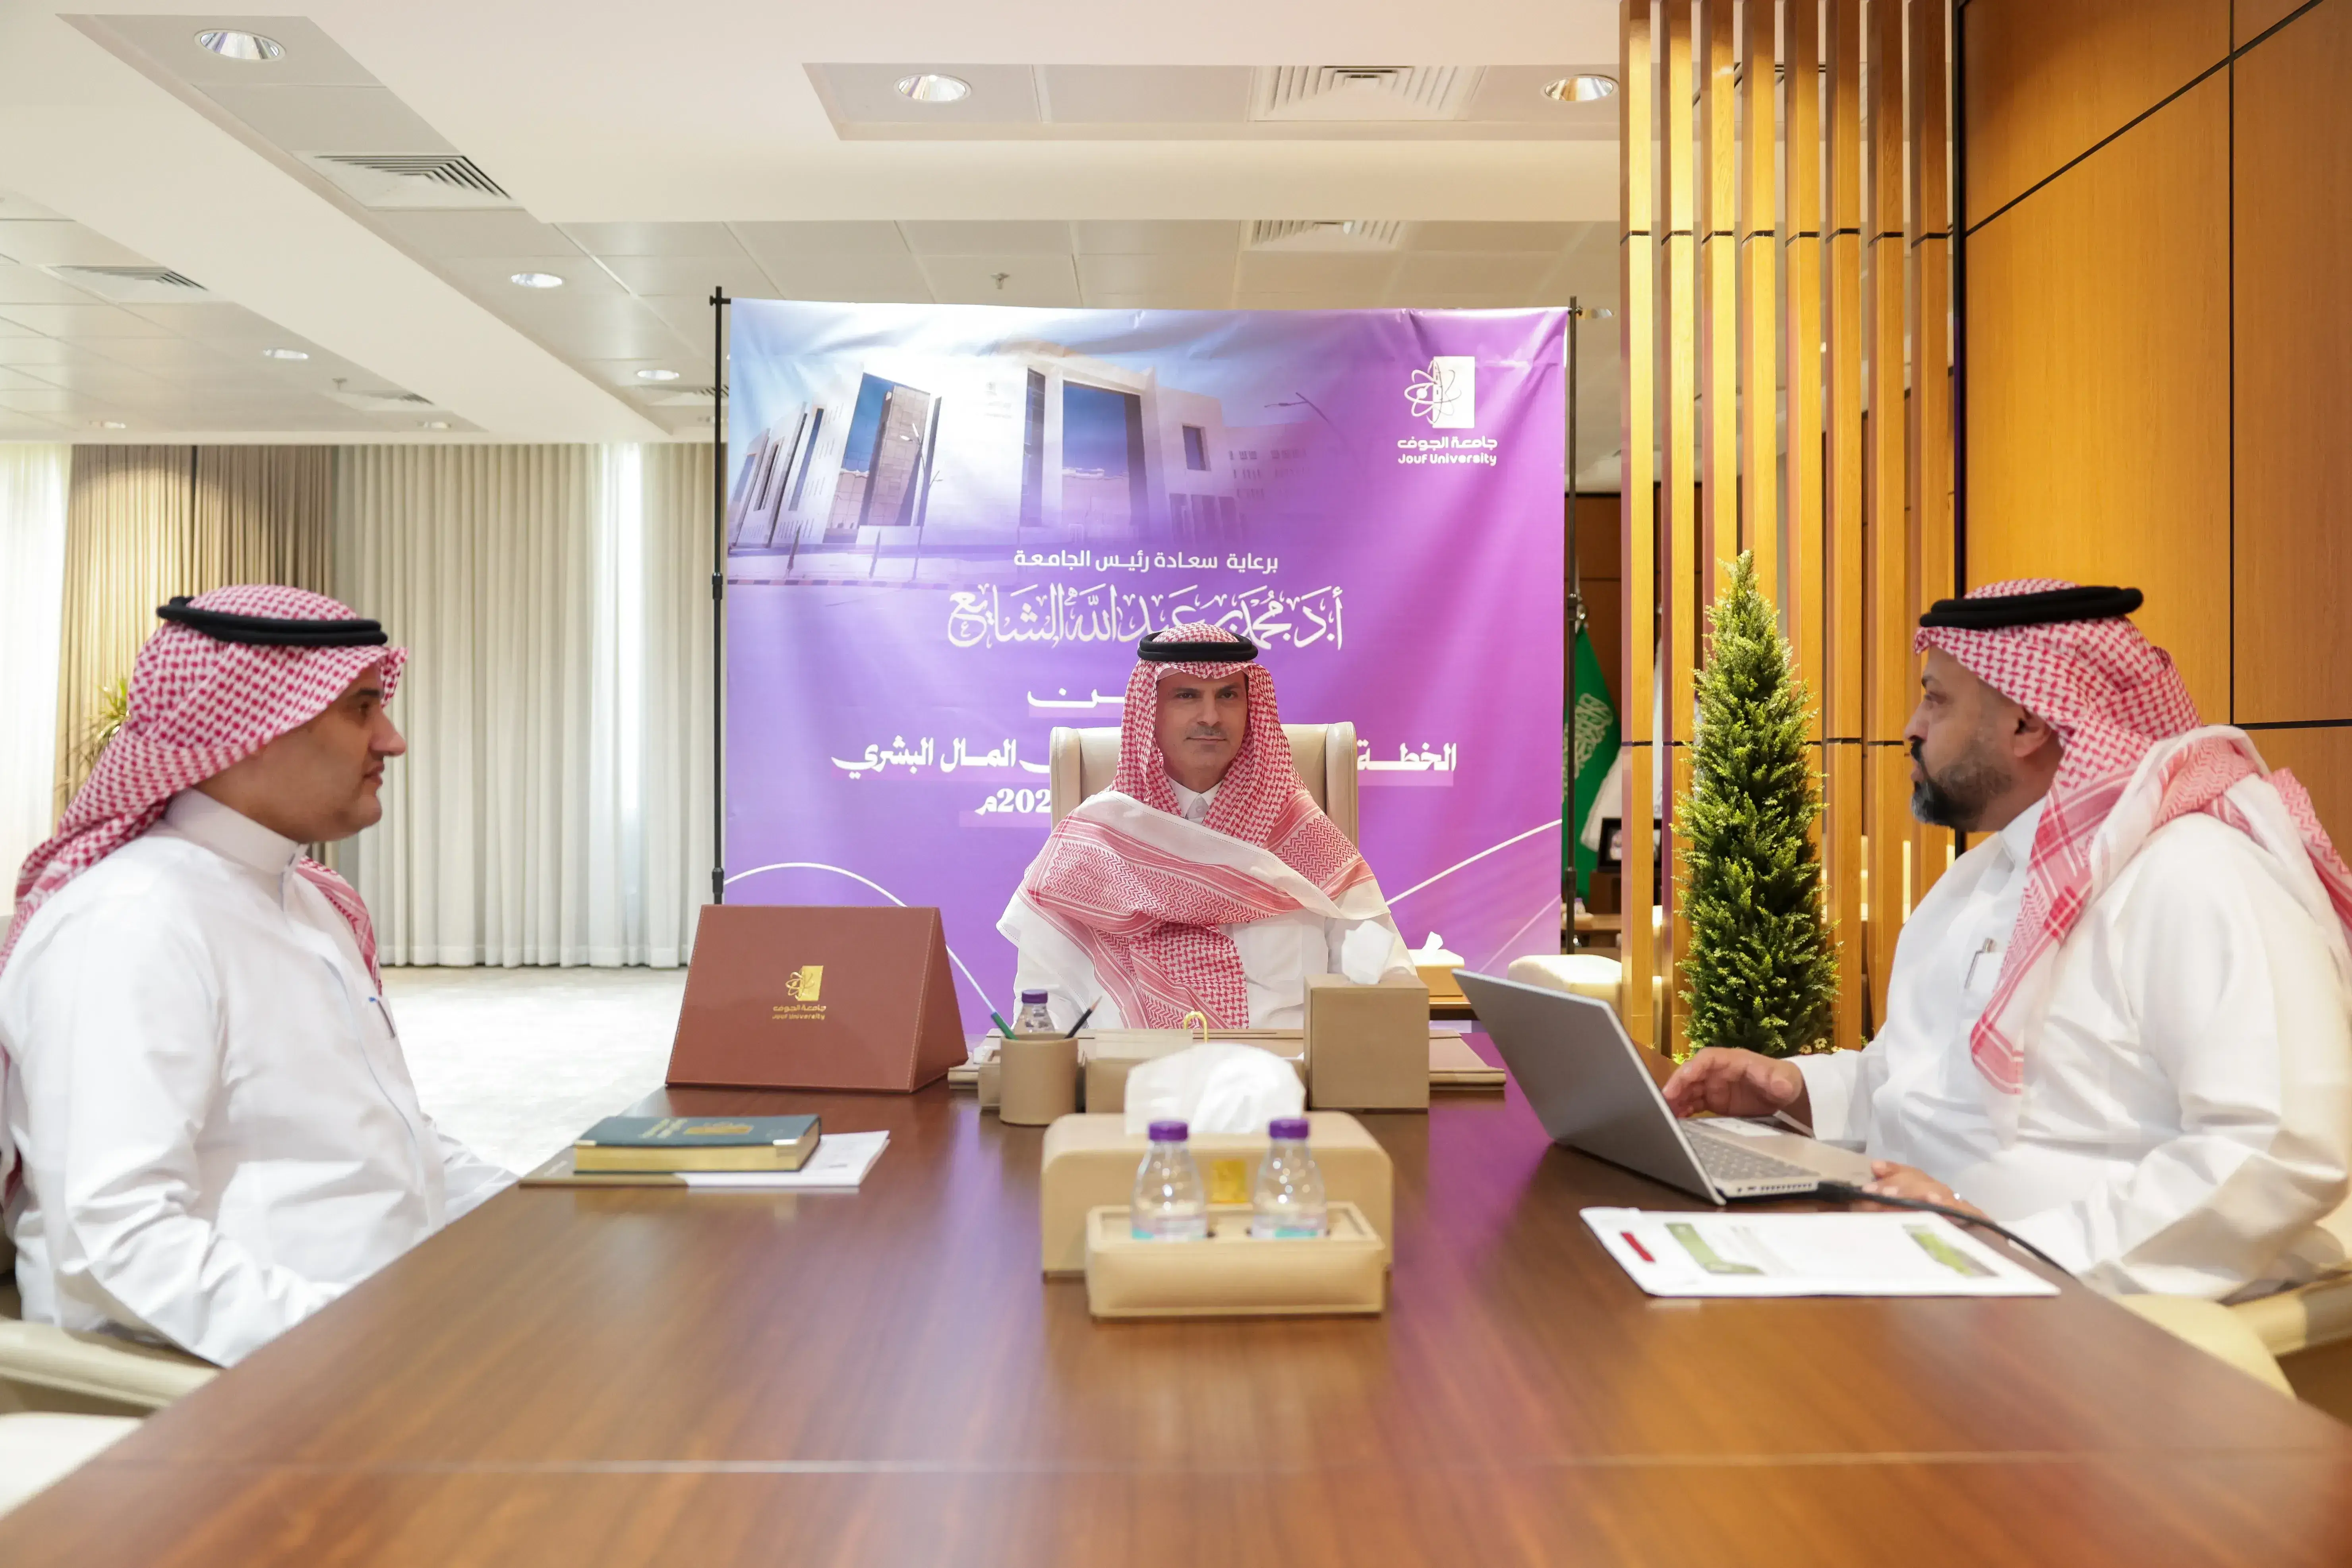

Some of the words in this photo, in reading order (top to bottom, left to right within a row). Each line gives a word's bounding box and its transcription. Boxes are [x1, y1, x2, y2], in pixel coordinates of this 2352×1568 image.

[1397, 436, 1449, 451] الجوف
[1451, 436, 1498, 450] جامعة
[1398, 453, 1427, 464] Jouf
[1429, 452, 1497, 466] University
[1014, 549, 1091, 571] الجامعة
[1095, 549, 1149, 573] رئيس
[1154, 551, 1218, 569] سعادة
[1226, 553, 1278, 574] برعاية
[831, 735, 934, 779] البشري
[940, 737, 1017, 773] المال
[1357, 739, 1457, 772] الخطة
[974, 788, 1051, 816] 202م
